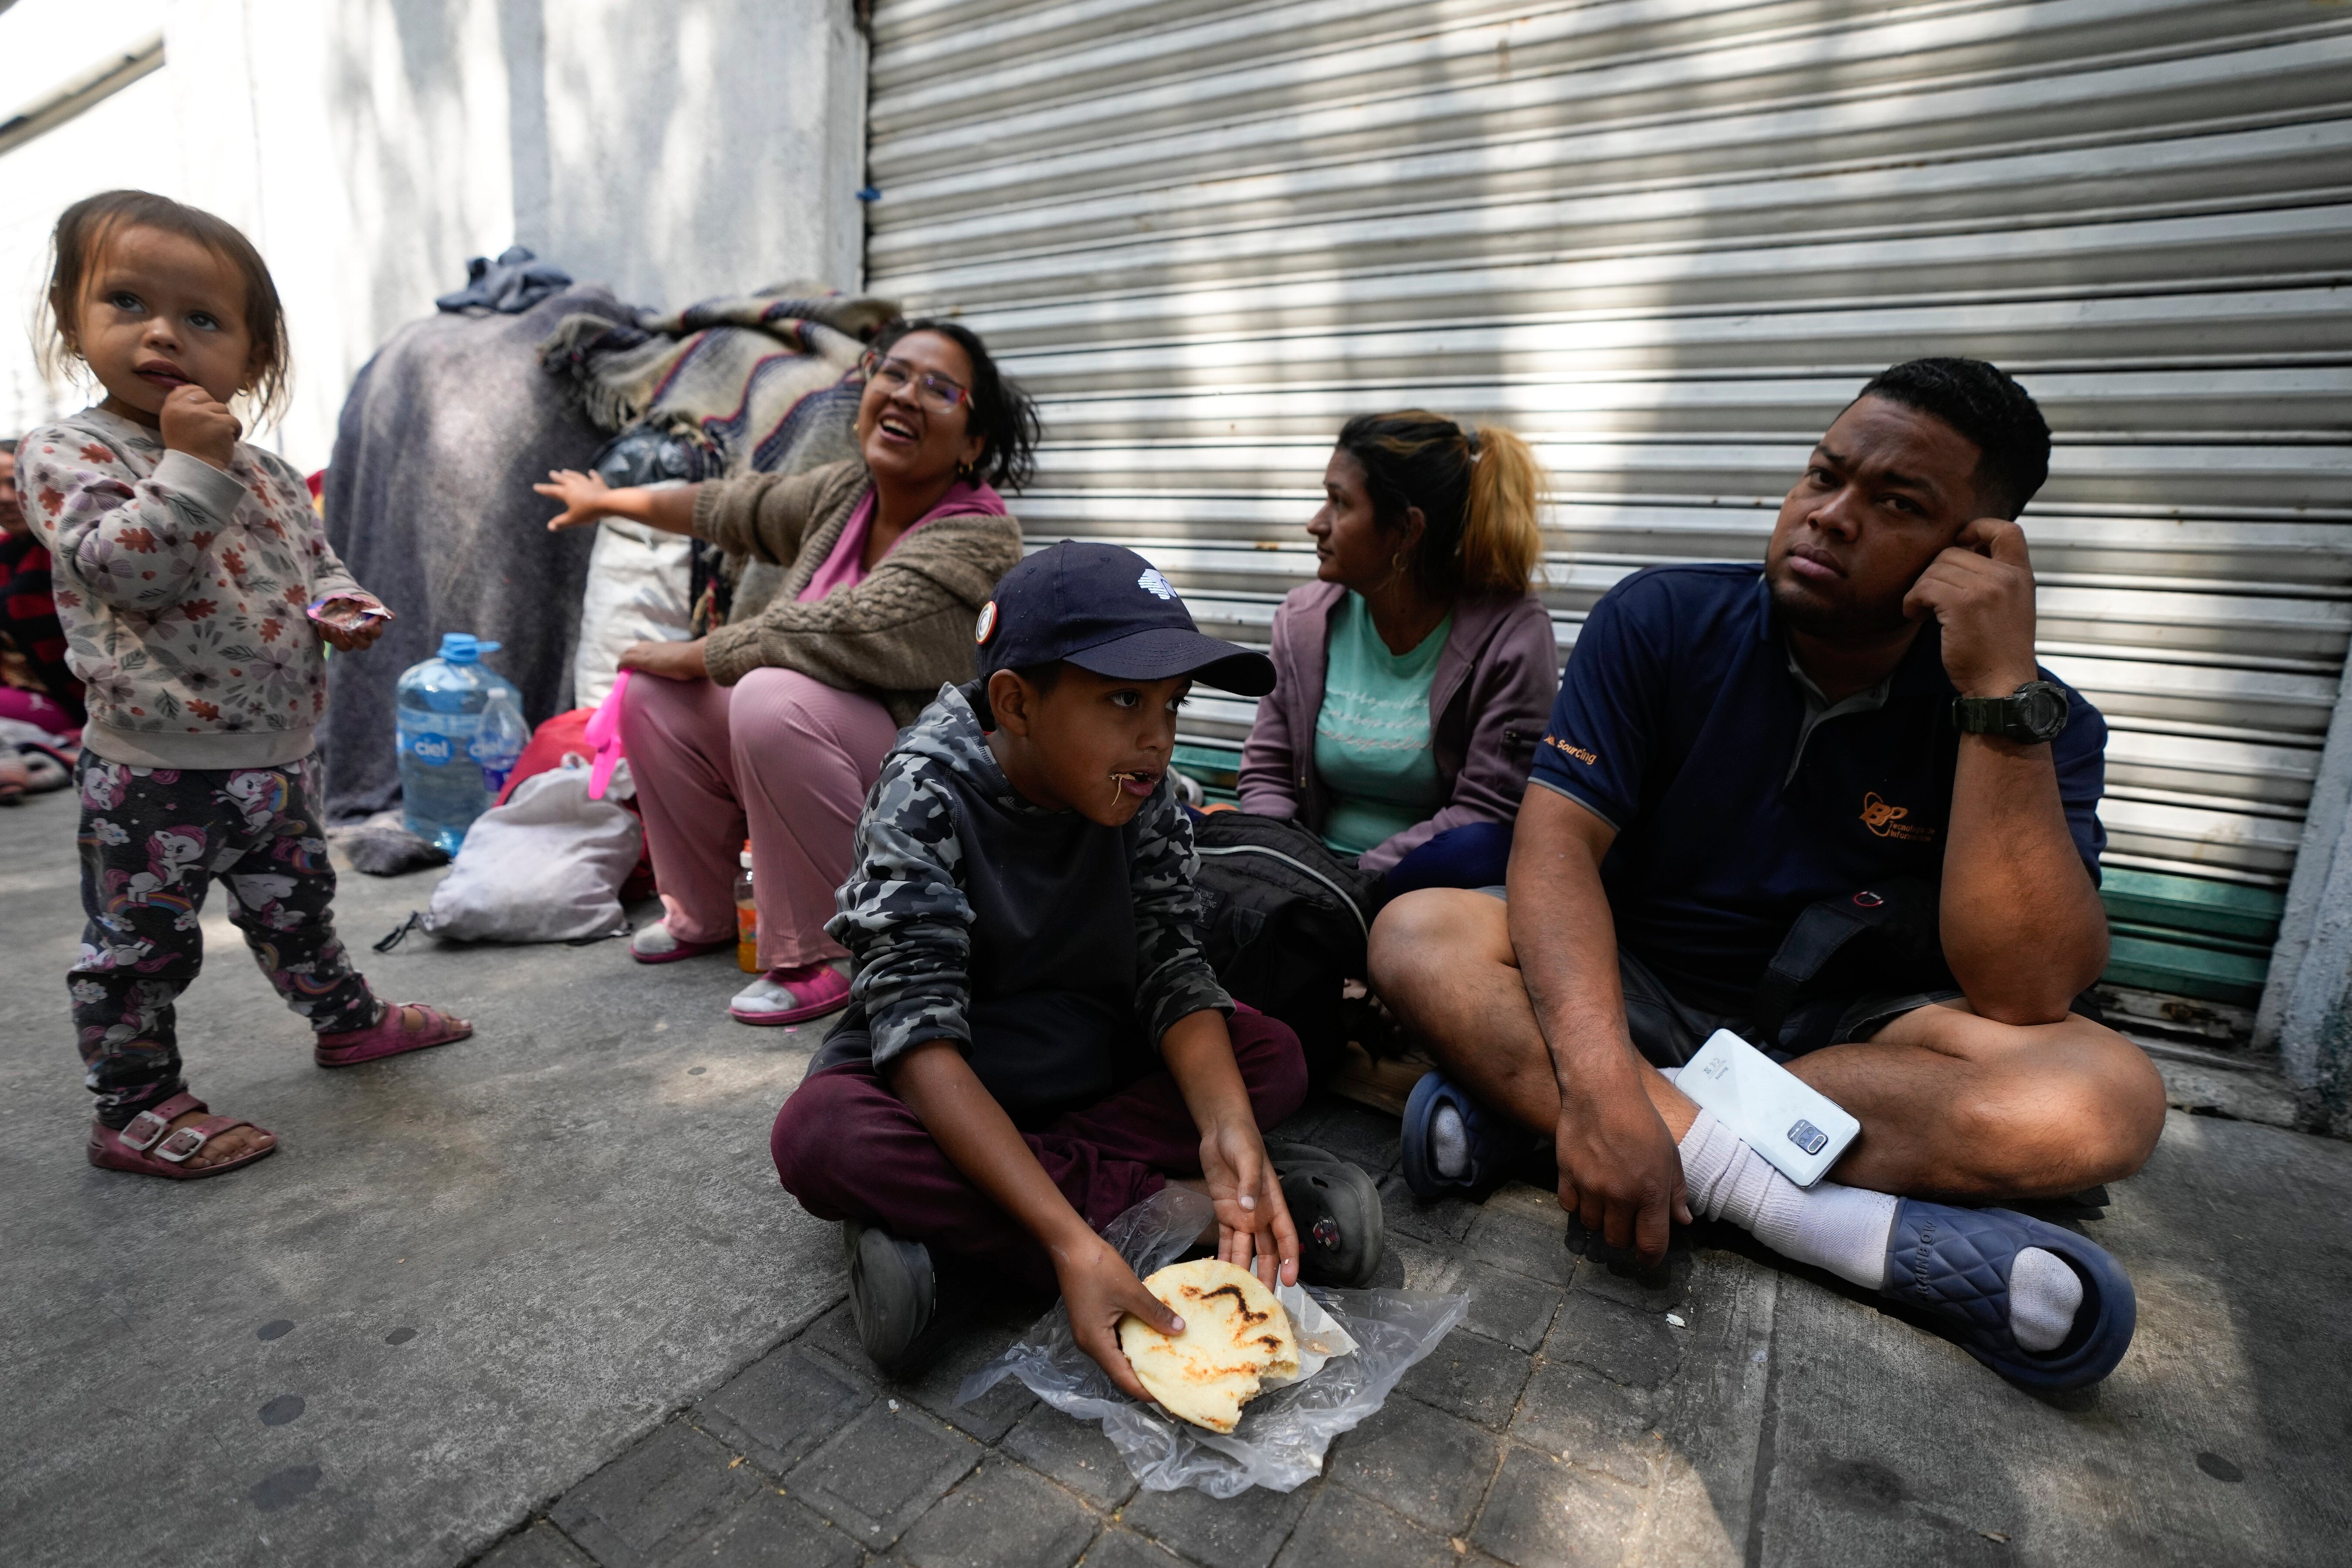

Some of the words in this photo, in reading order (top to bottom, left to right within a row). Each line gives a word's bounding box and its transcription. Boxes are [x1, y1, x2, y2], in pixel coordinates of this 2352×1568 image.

[415, 737, 448, 758] ciel
[1557, 739, 1597, 765] Sourcing
[1200, 897, 1217, 908] ELING
[1715, 1066, 1729, 1080] Redmi
[1915, 1220, 1937, 1295] RAINBOW
